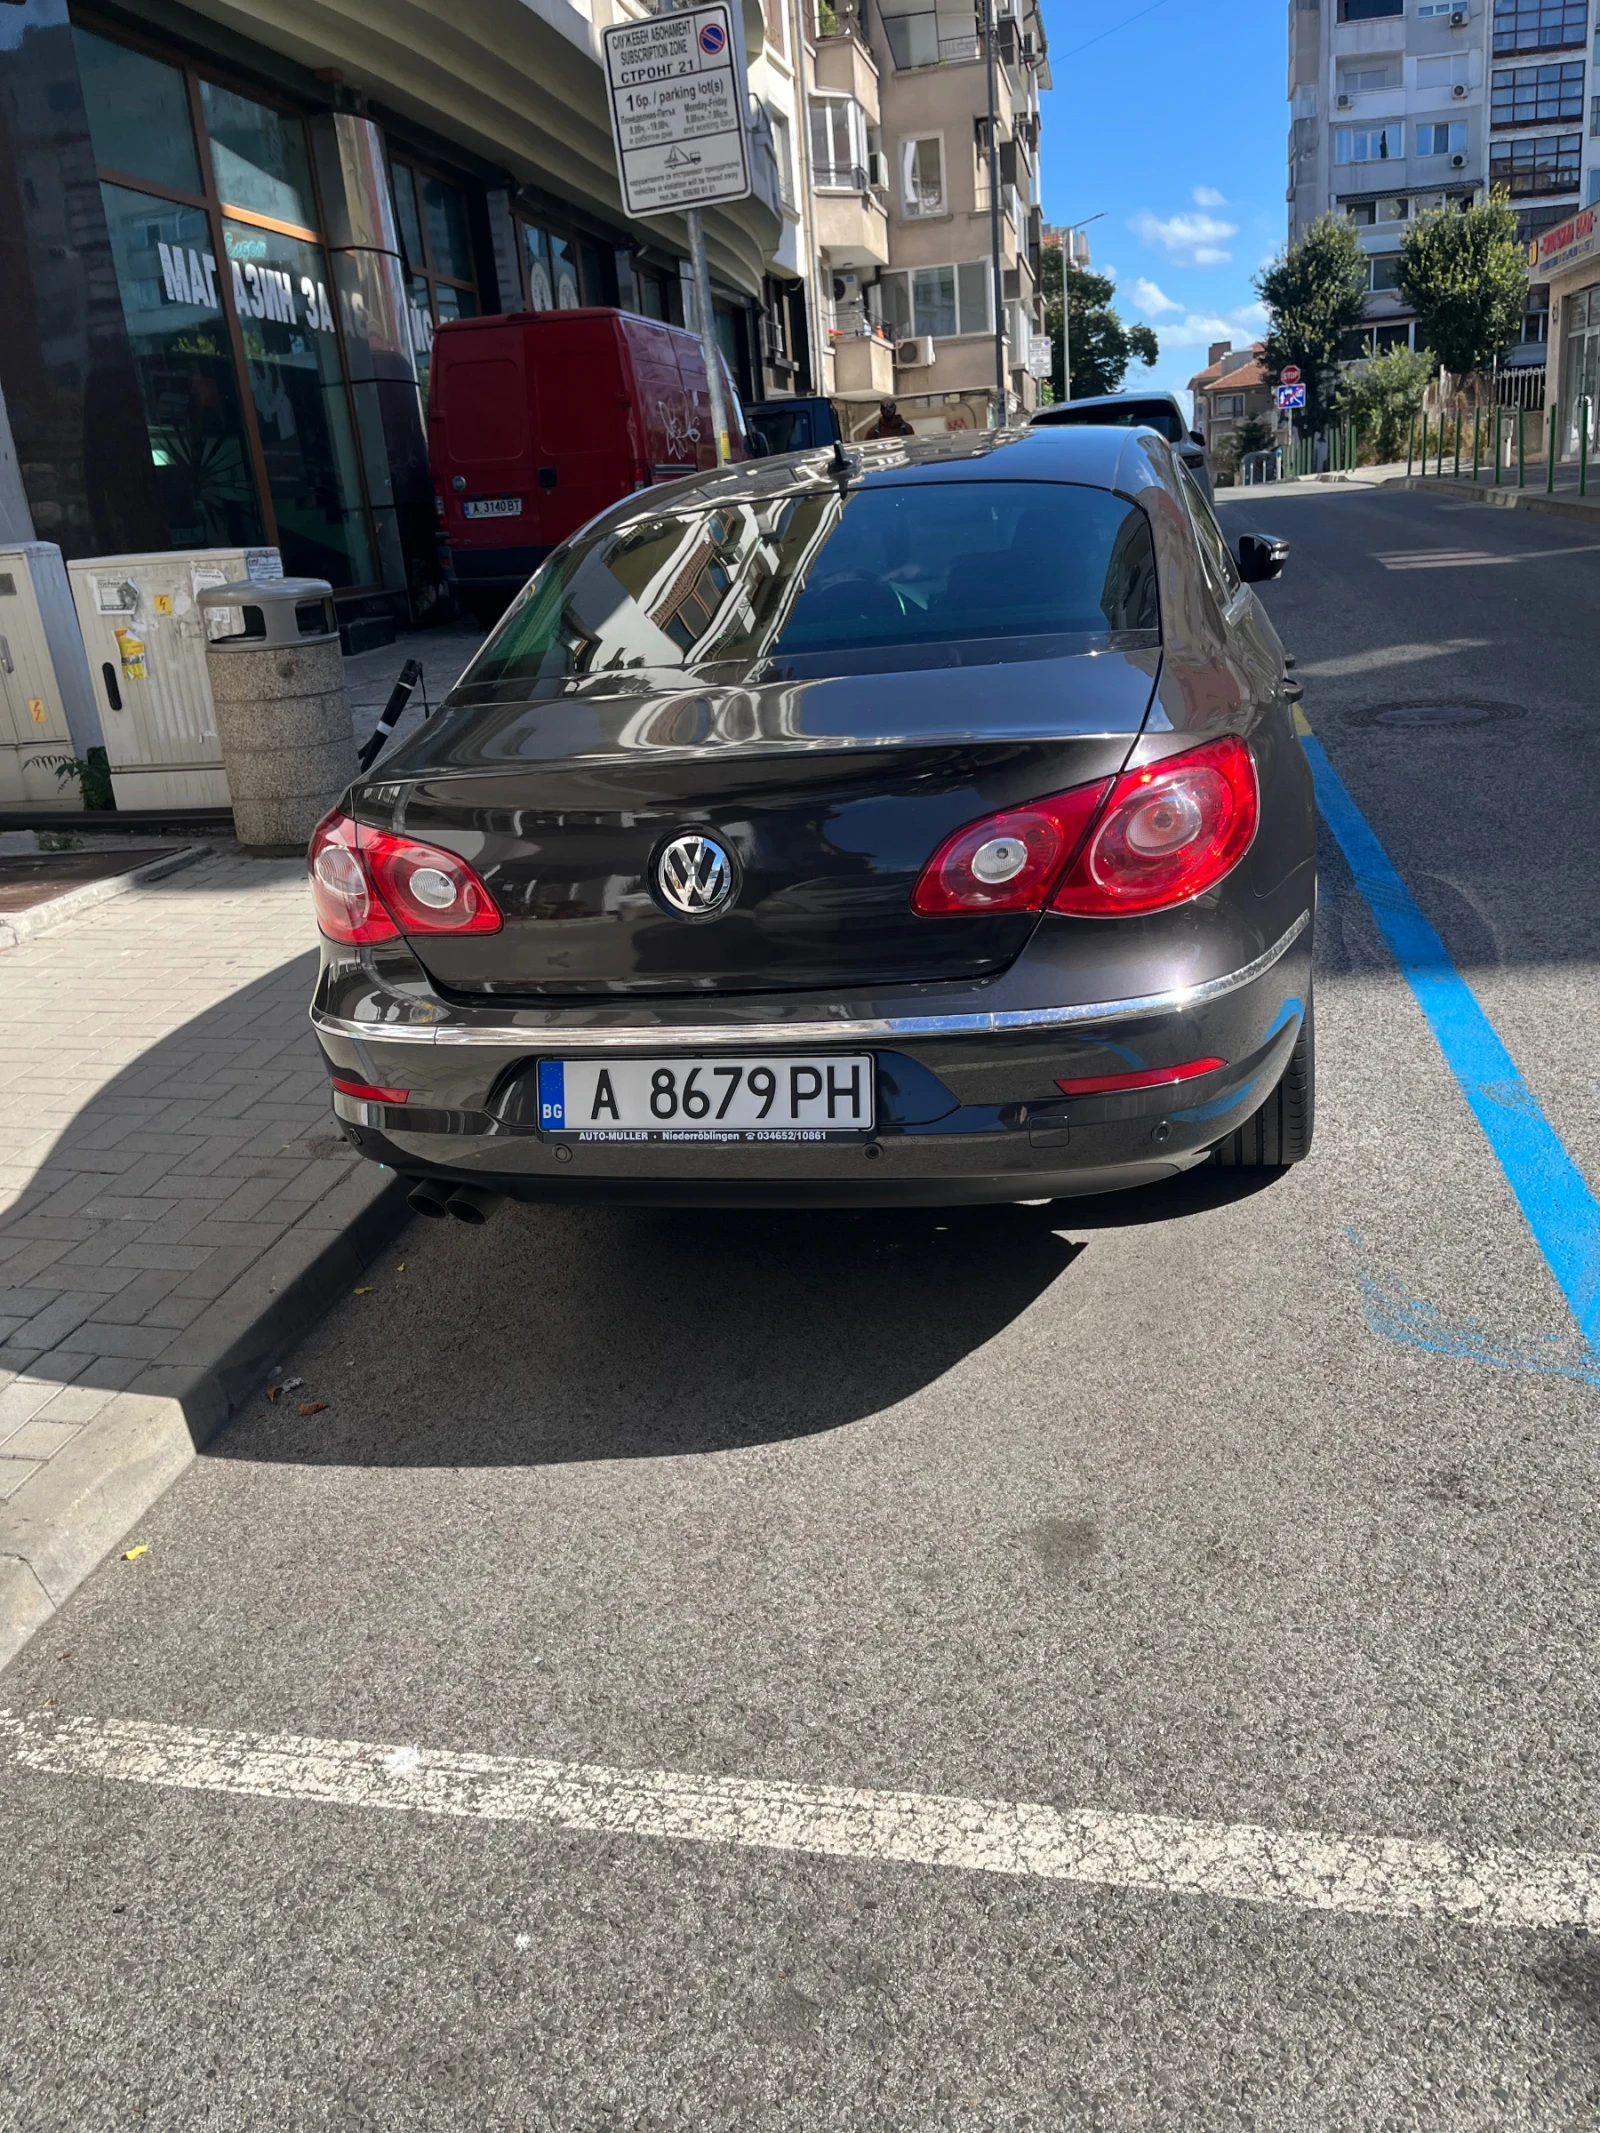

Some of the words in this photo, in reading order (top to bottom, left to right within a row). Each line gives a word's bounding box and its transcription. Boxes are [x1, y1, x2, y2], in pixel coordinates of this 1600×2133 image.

[612, 29, 649, 50] СЛУЖЕБЕН
[651, 21, 691, 41] АБОНАМЕНТ
[621, 43, 669, 66] SUBSCRIPTION
[669, 39, 688, 56] ZONE
[621, 63, 674, 84] СТРОНГ
[679, 60, 694, 73] 21
[626, 94, 634, 112] 1
[660, 86, 696, 105] parking
[698, 78, 724, 96] lot(s)
[301, 276, 336, 333] ЗА
[542, 1103, 563, 1119] BG
[590, 1068, 620, 1120] A
[662, 1131, 740, 1142] Niederröblingen
[757, 1131, 827, 1141] 034652/10861
